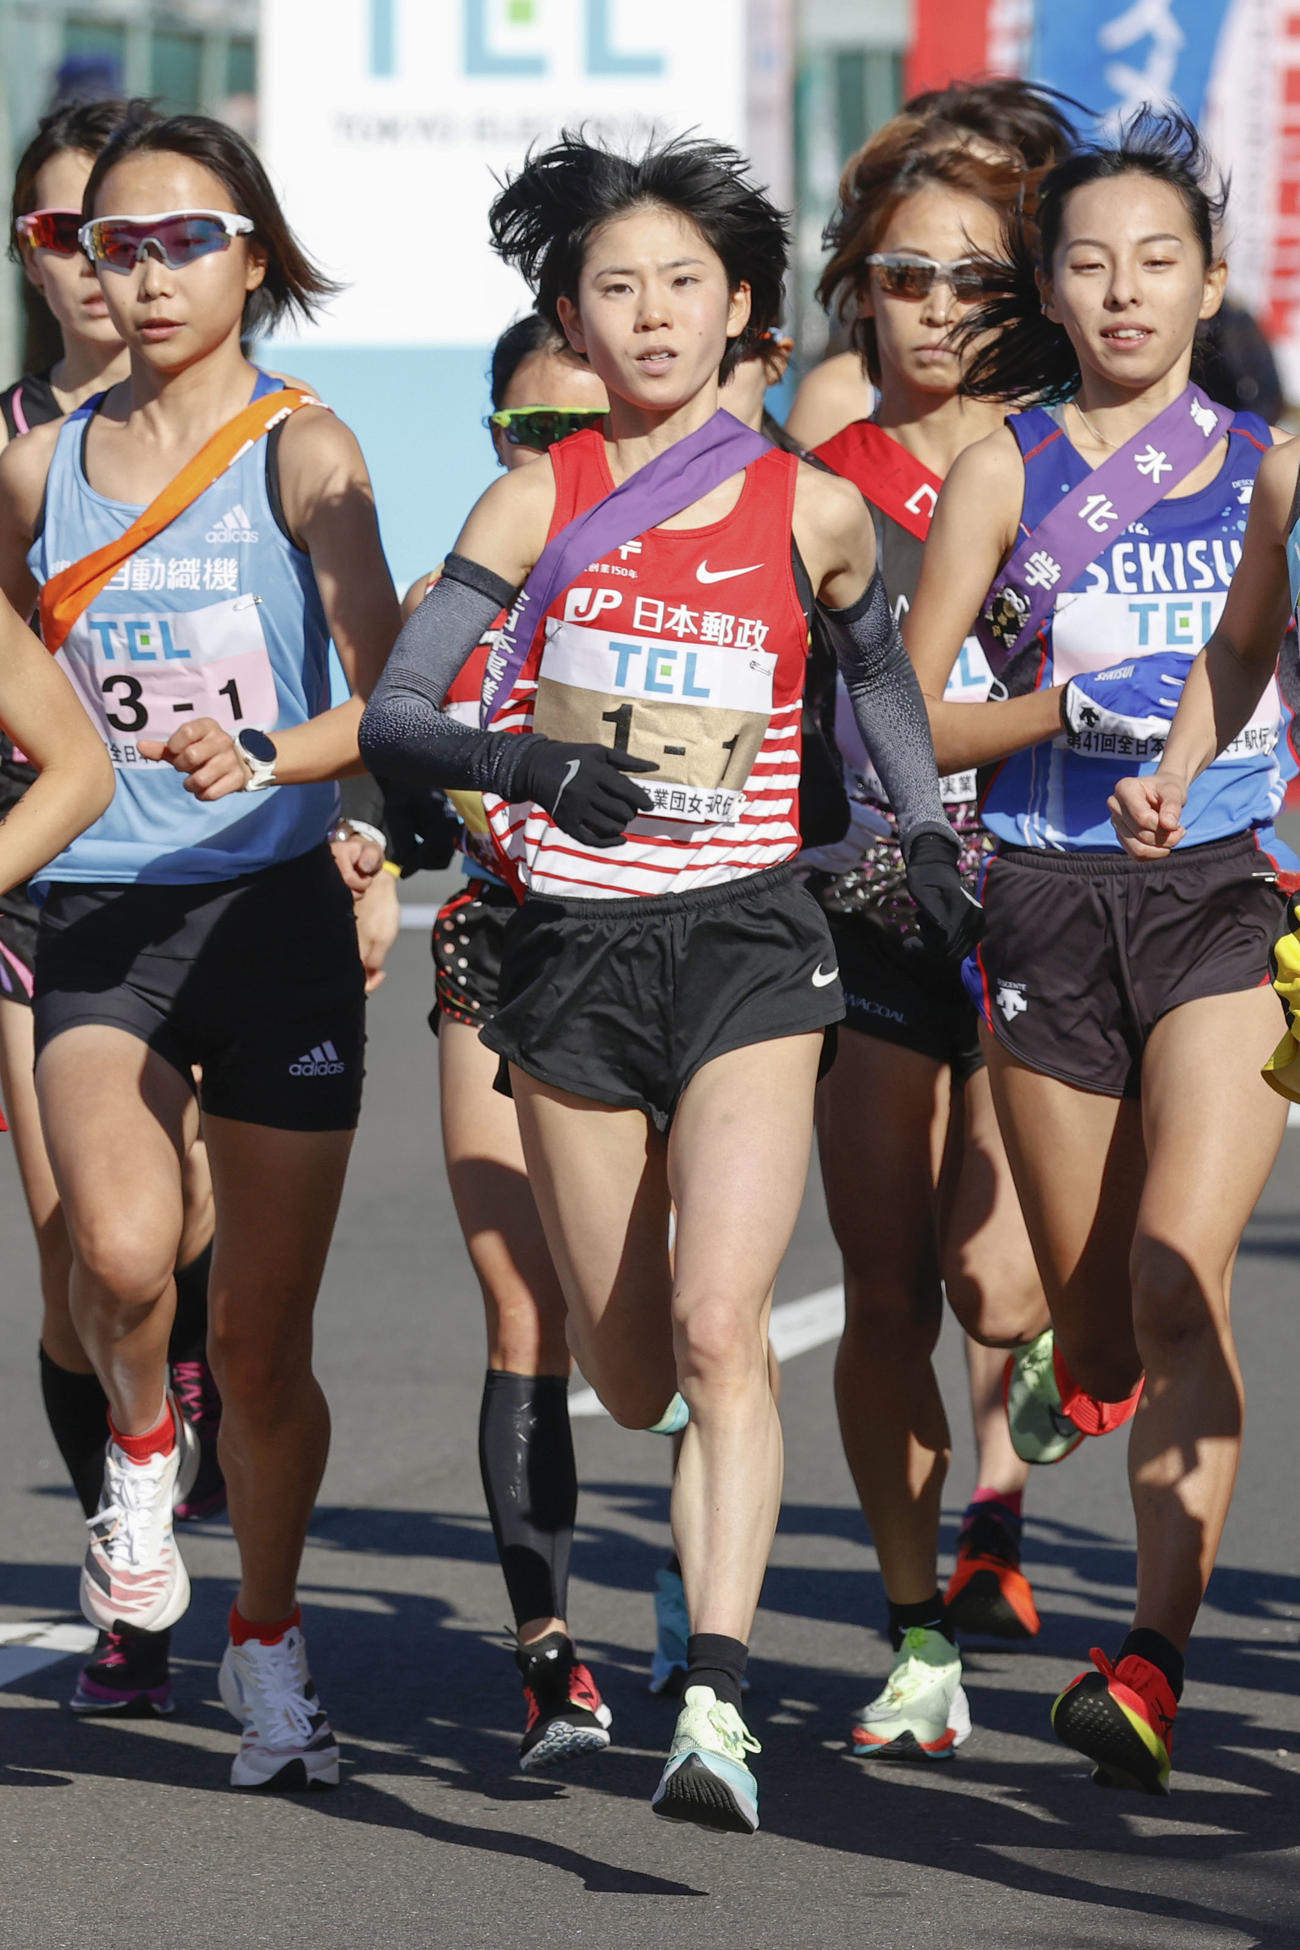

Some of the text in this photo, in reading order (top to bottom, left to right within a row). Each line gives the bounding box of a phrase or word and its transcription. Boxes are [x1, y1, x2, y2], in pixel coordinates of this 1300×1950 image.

[205, 529, 259, 544] adidas
[51, 557, 240, 592] 自動織機
[564, 587, 770, 653] JP 日本郵政
[90, 620, 191, 661] TEL
[609, 642, 711, 699] TEL
[289, 1061, 345, 1077] adidas
